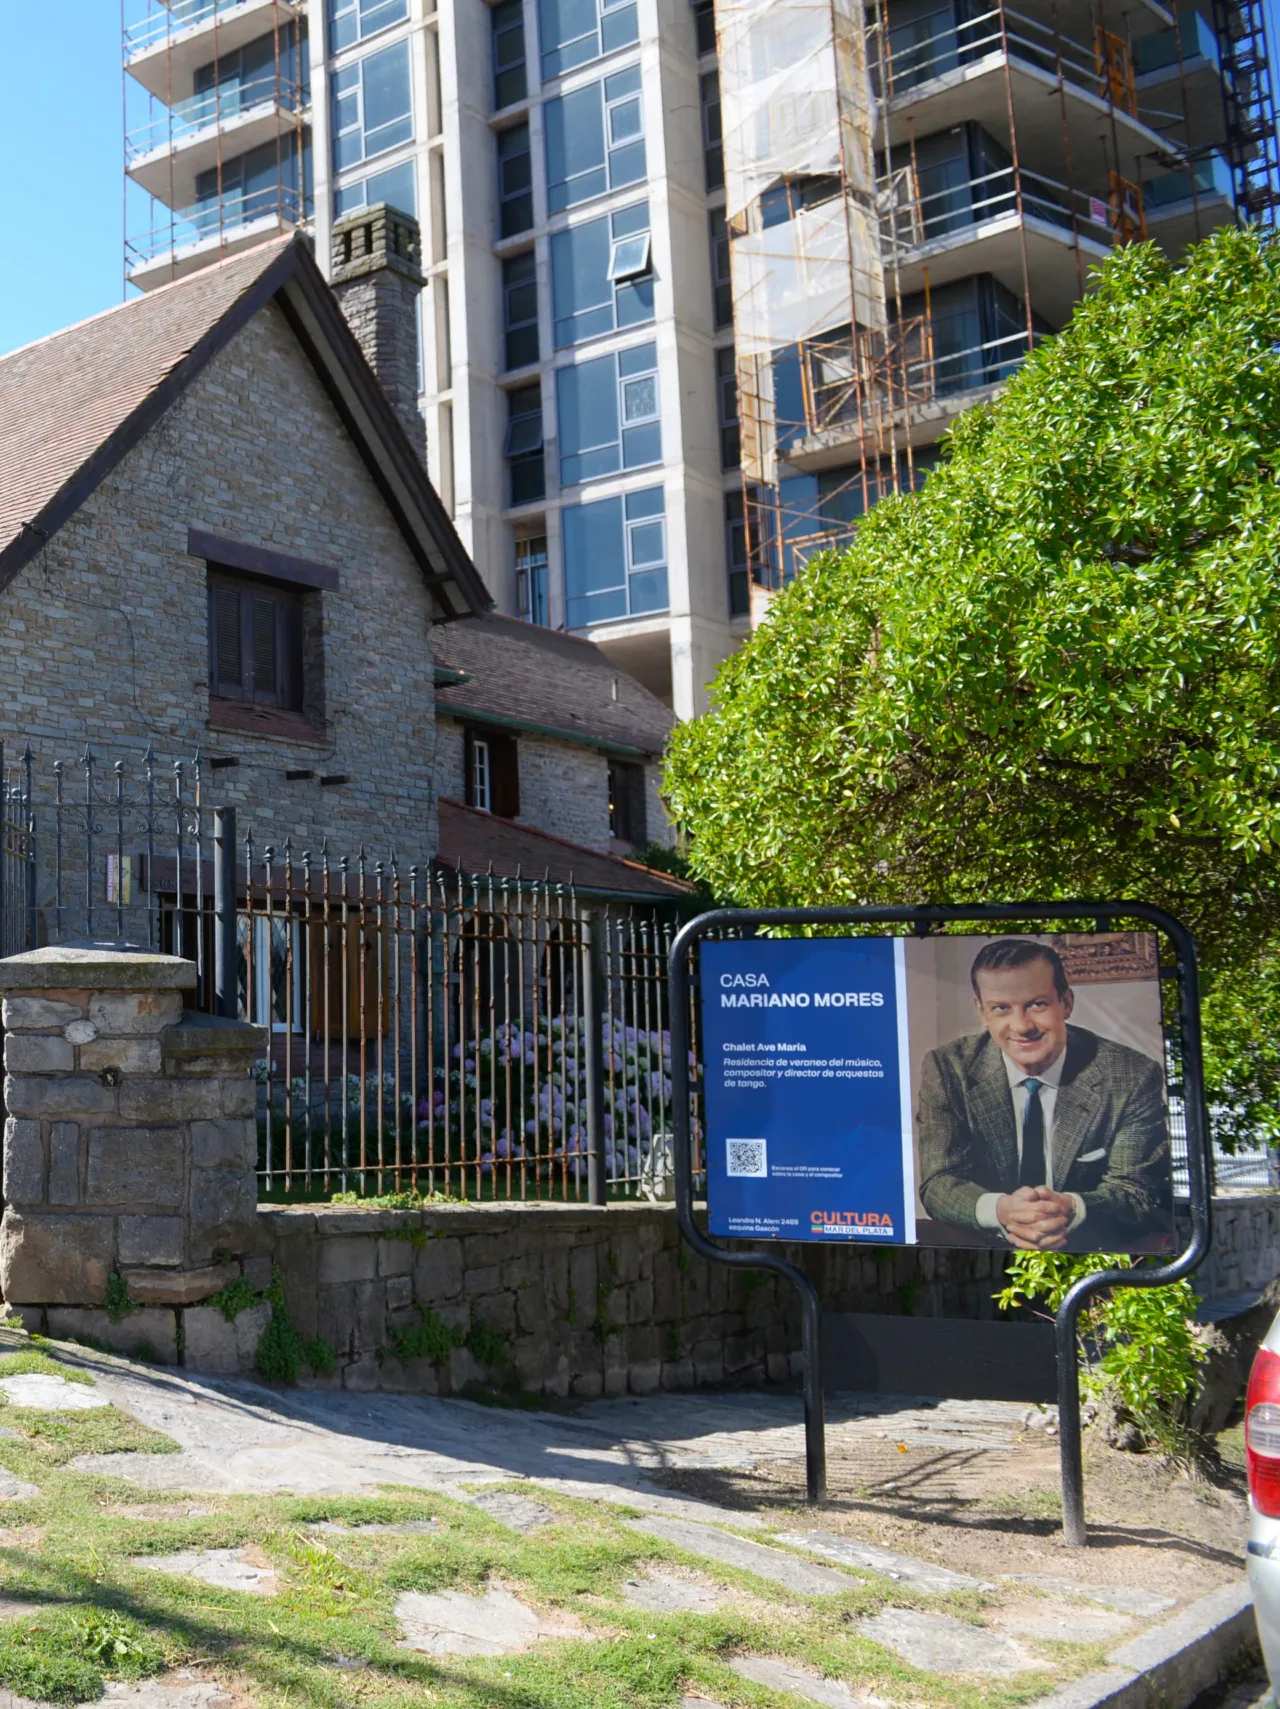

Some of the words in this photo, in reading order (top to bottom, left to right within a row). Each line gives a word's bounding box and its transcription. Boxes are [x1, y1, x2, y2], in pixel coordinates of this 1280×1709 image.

[720, 973, 770, 988] CASA
[721, 994, 810, 1008] MARIANO
[814, 992, 884, 1007] MORES
[722, 1043, 756, 1052] Chalet
[757, 1043, 776, 1052] Ave
[723, 1058, 774, 1067] Residencia
[776, 1058, 788, 1067] de
[789, 1059, 827, 1067] veraneo
[829, 1058, 844, 1067] del
[845, 1058, 882, 1068] músico,
[723, 1069, 776, 1079] compositor
[776, 1070, 783, 1079] y
[784, 1069, 821, 1078] director
[822, 1069, 834, 1078] de
[835, 1070, 884, 1079] orquestas
[724, 1079, 736, 1088] de
[737, 1080, 767, 1089] tango.
[811, 1211, 893, 1227] CULTURA
[728, 1224, 754, 1232] esquina
